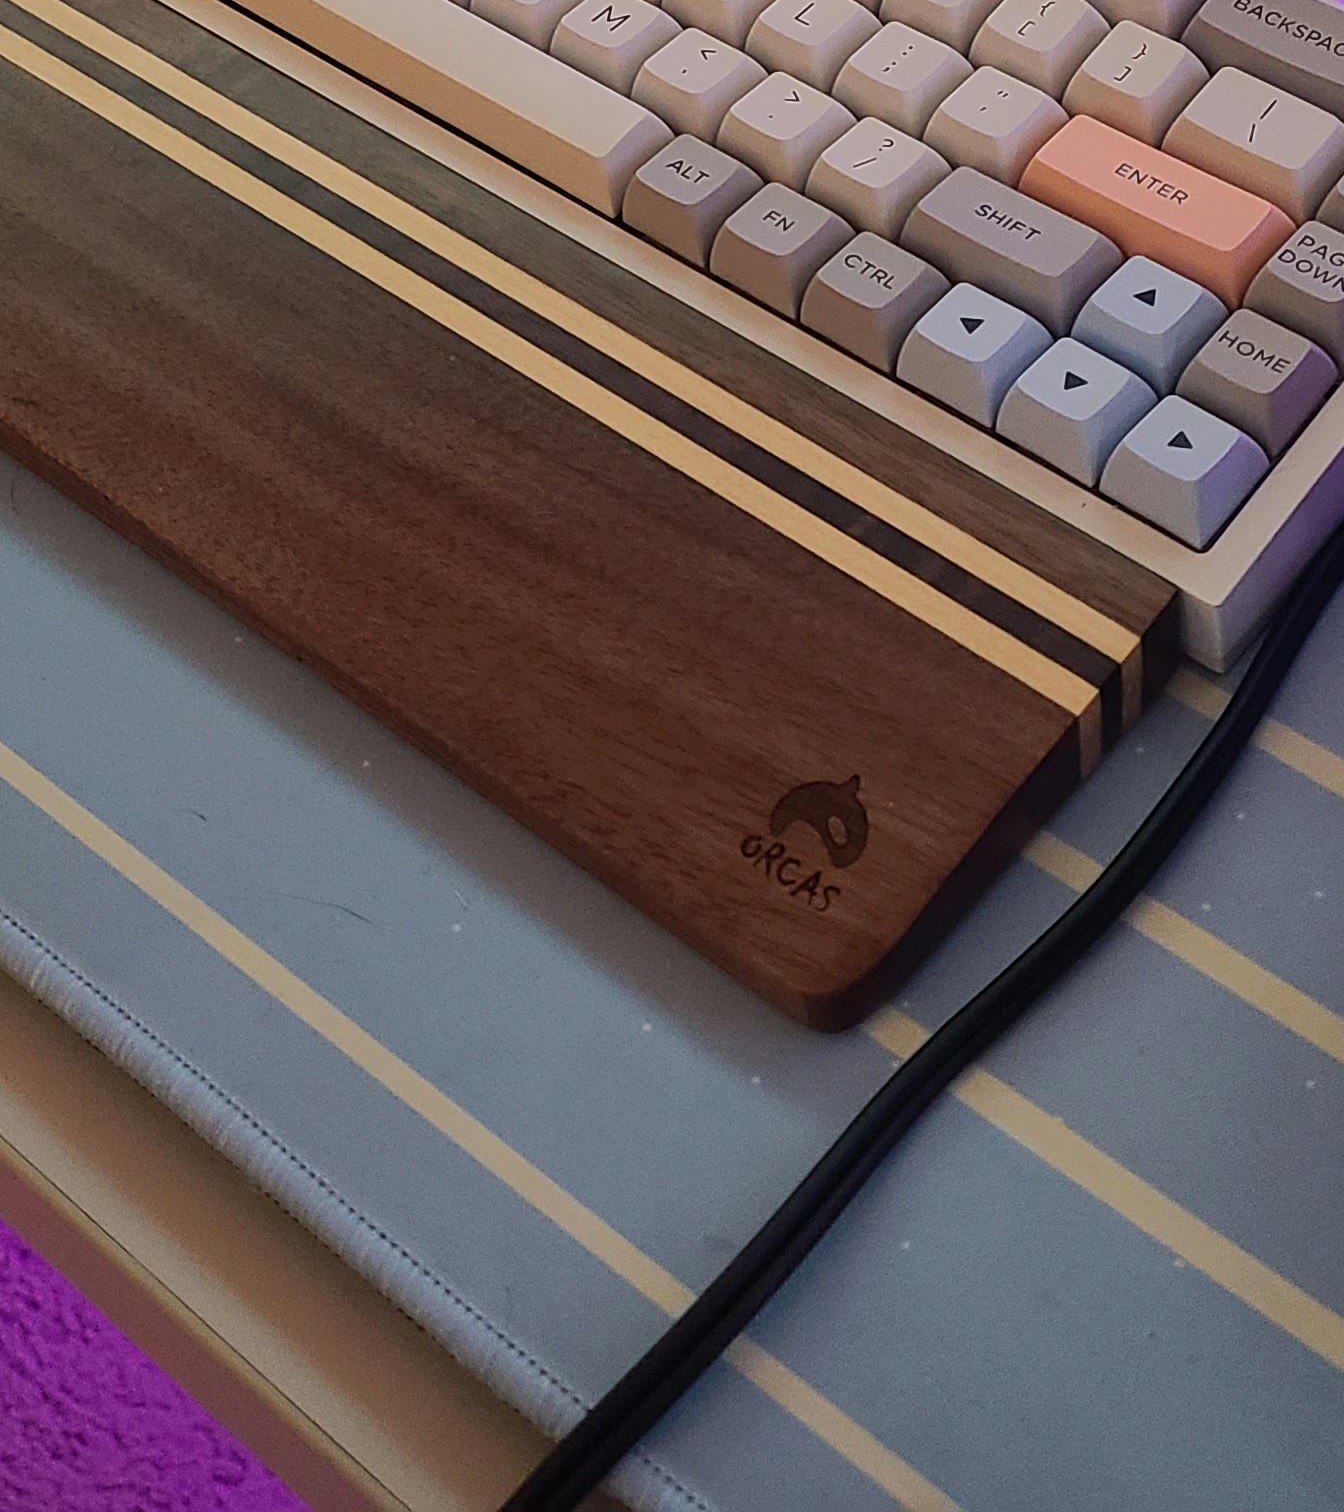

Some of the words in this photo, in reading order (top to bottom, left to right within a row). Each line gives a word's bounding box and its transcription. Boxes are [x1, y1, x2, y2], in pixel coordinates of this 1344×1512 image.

[591, 5, 631, 32] M
[793, 2, 815, 26] L
[665, 159, 710, 184] ALT
[1114, 162, 1189, 205] ENTER
[762, 210, 796, 232] FN
[974, 204, 1042, 240] SHIFT
[844, 254, 895, 290] CTRL
[1217, 329, 1291, 374] HOME
